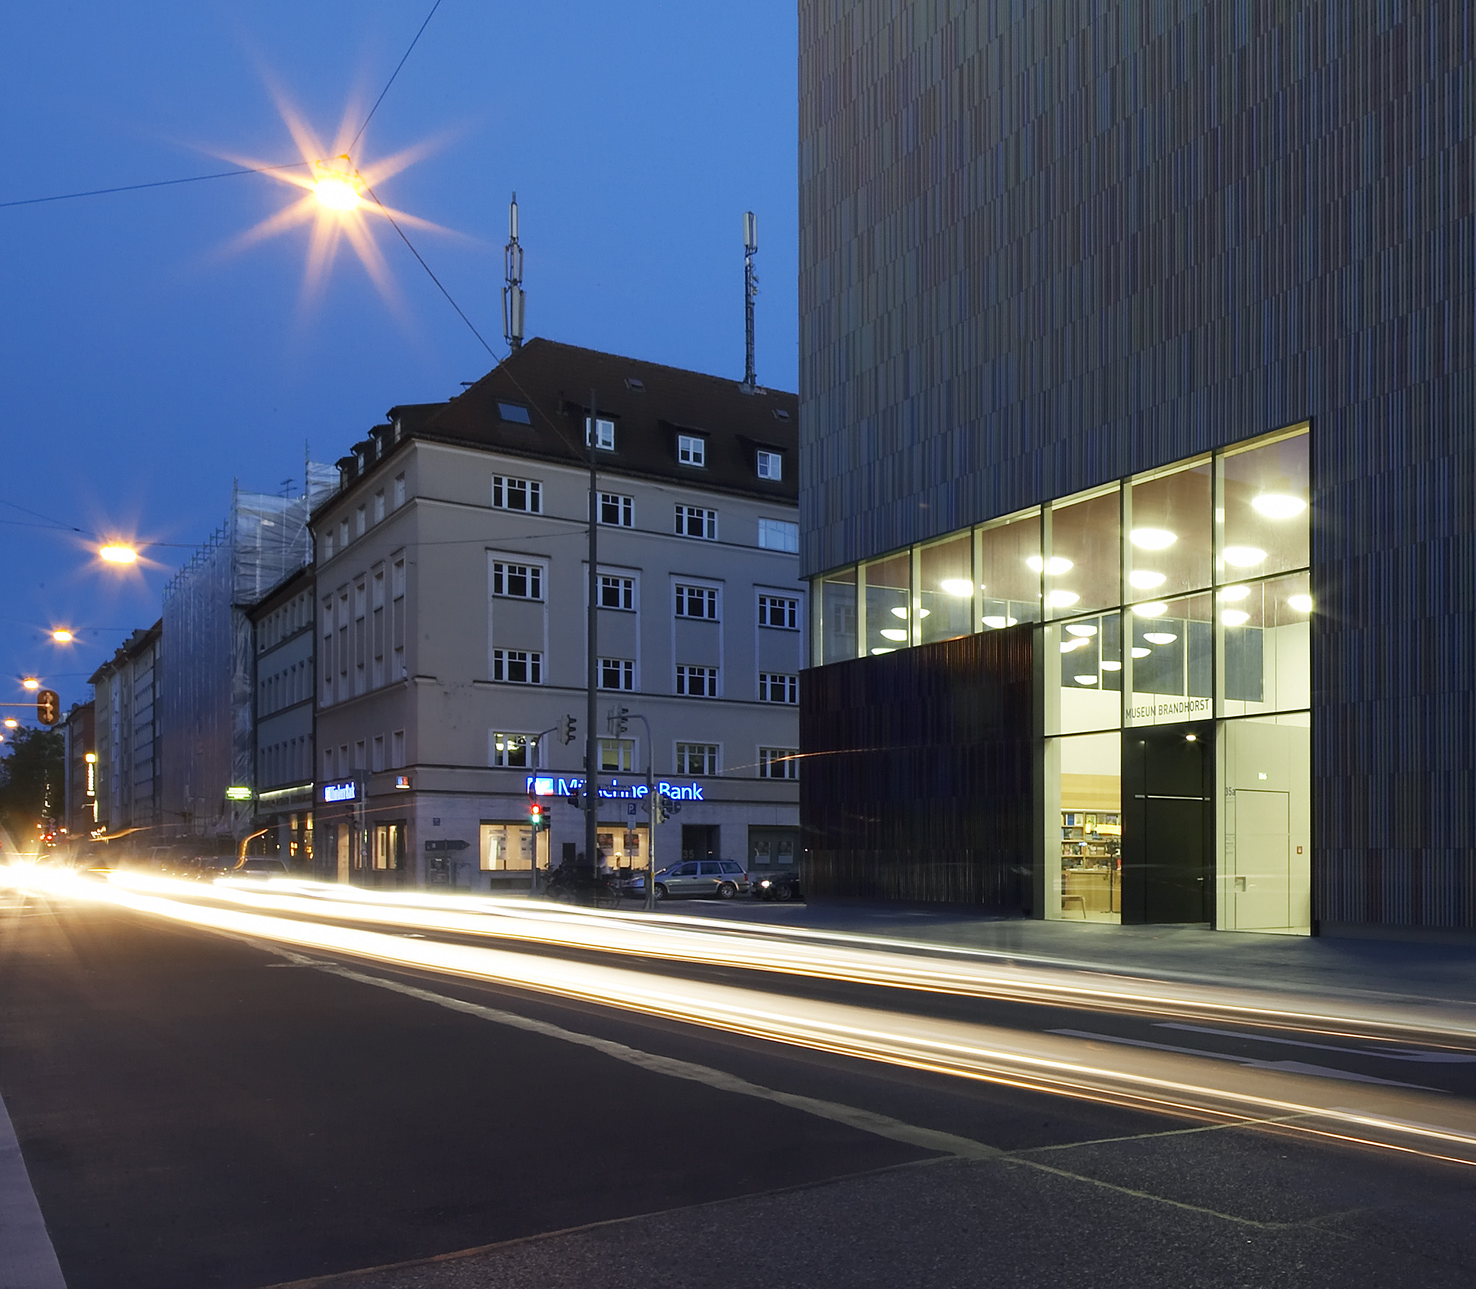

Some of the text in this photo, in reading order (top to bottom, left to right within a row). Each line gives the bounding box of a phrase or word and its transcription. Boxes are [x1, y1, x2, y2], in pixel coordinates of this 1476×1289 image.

[1126, 699, 1210, 718] MUSEUM BRANDHORST
[659, 782, 704, 800] Bank
[683, 849, 695, 859] 35
